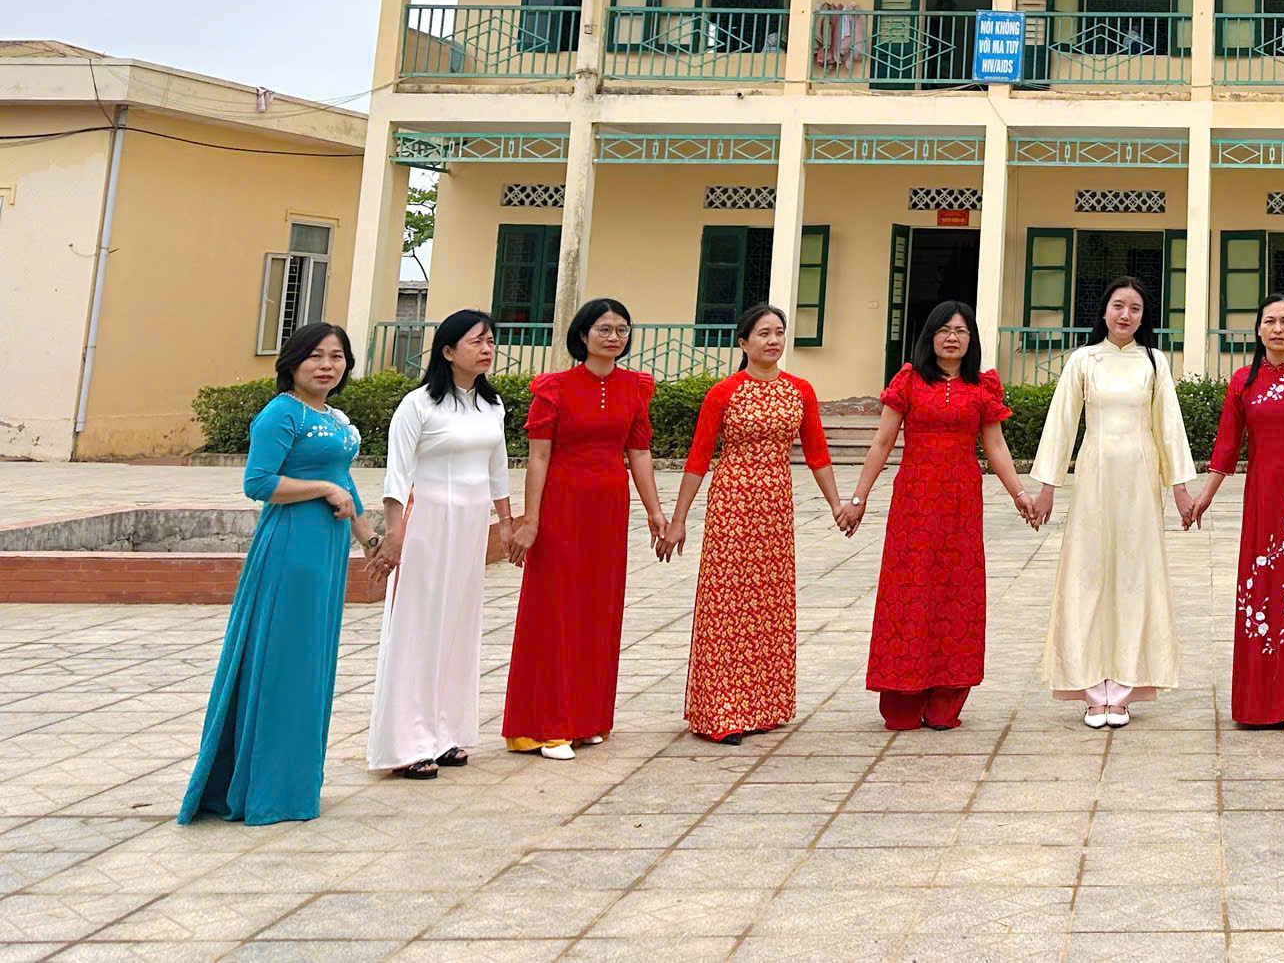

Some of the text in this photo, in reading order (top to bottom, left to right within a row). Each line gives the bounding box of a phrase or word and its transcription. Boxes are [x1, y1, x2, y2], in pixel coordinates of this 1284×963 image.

[994, 18, 1020, 35] KHÔNG
[992, 39, 1004, 54] MA
[981, 58, 1014, 74] HIV/AIDS
